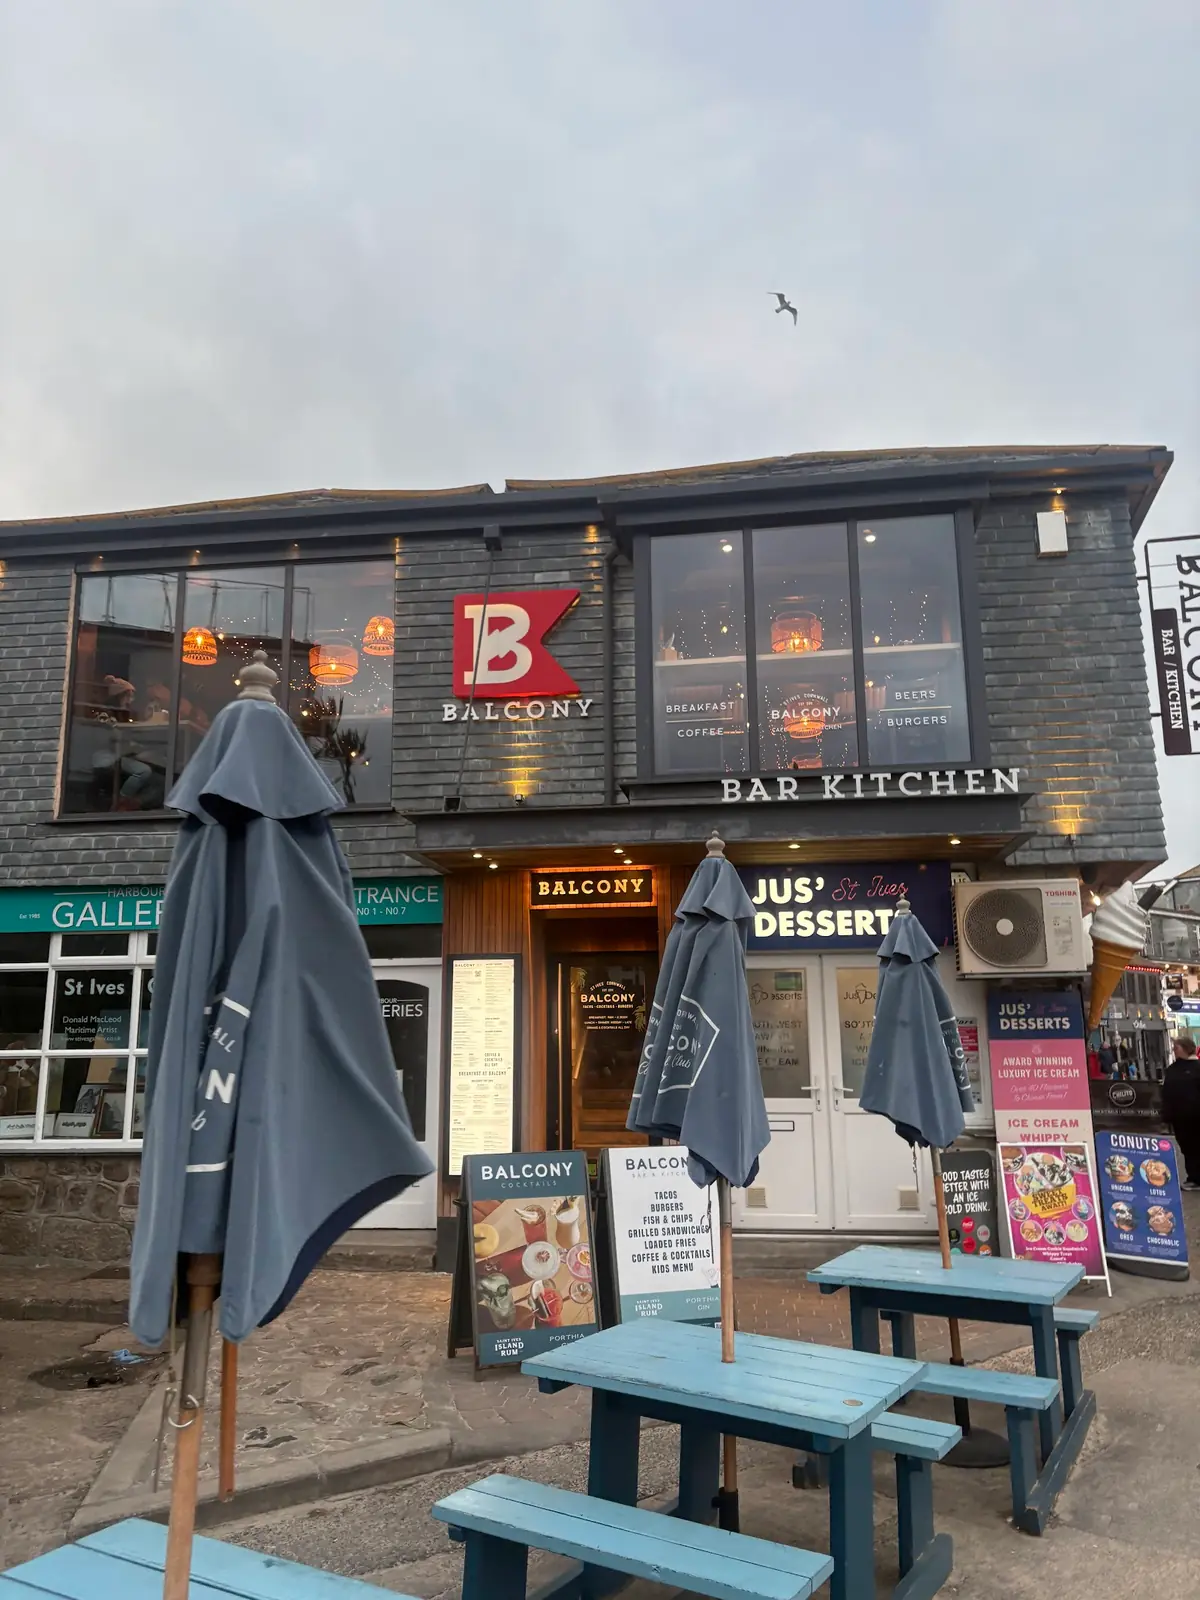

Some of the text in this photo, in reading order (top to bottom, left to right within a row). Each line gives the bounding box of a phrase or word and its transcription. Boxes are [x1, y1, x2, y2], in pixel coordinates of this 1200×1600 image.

[1161, 628, 1175, 656] BAR
[895, 690, 936, 700] BEERS
[1165, 669, 1184, 730] KITCHEN
[442, 699, 593, 721] BALCONY
[666, 702, 734, 713] BREAKFAST
[771, 706, 840, 720] BALCONY
[887, 715, 947, 727] BURGERS
[677, 727, 724, 737] COFFEE
[721, 767, 1020, 802] BAR KITCHEN
[538, 878, 644, 895] BALCONY
[752, 876, 825, 904] JUS'
[831, 877, 860, 902] St
[754, 908, 911, 938] DESSERT
[64, 978, 125, 996] St Ives
[580, 993, 635, 1003] BALCONY
[999, 1003, 1031, 1015] JUS'
[1000, 1017, 1070, 1030] DESSERTS
[65, 1026, 95, 1034] Maritime
[1003, 1056, 1073, 1066] AWARD WINNING
[998, 1069, 1080, 1079] LUXURY ICE CREAM
[1008, 1119, 1079, 1129] ICE CREAM
[1020, 1133, 1068, 1142] WHIPPY
[1111, 1134, 1159, 1151] CONUTS
[481, 1162, 572, 1180] BALCONY
[960, 1168, 989, 1180] TASTES
[970, 1179, 989, 1191] WITH
[655, 1190, 677, 1200] TACOS
[953, 1191, 979, 1203] AN ICE
[1032, 1187, 1061, 1200] SWEET
[1150, 1188, 1166, 1196] LOTUS
[1032, 1193, 1068, 1207] TREATS
[651, 1202, 684, 1212] BURGERS
[964, 1201, 990, 1213] DRINK.
[643, 1214, 693, 1225] FISH & CHIPS
[628, 1224, 710, 1238] GRILLED SANDWICHES
[644, 1238, 696, 1249] LOADED FRIES
[632, 1249, 711, 1263] COFFEE & COCKTAILS
[652, 1262, 694, 1274] KIDS MENU
[686, 1296, 719, 1304] PORTHIA
[635, 1303, 662, 1311] ISLAND
[550, 1333, 584, 1342] PORTHIA
[495, 1342, 524, 1351] ISLAND
